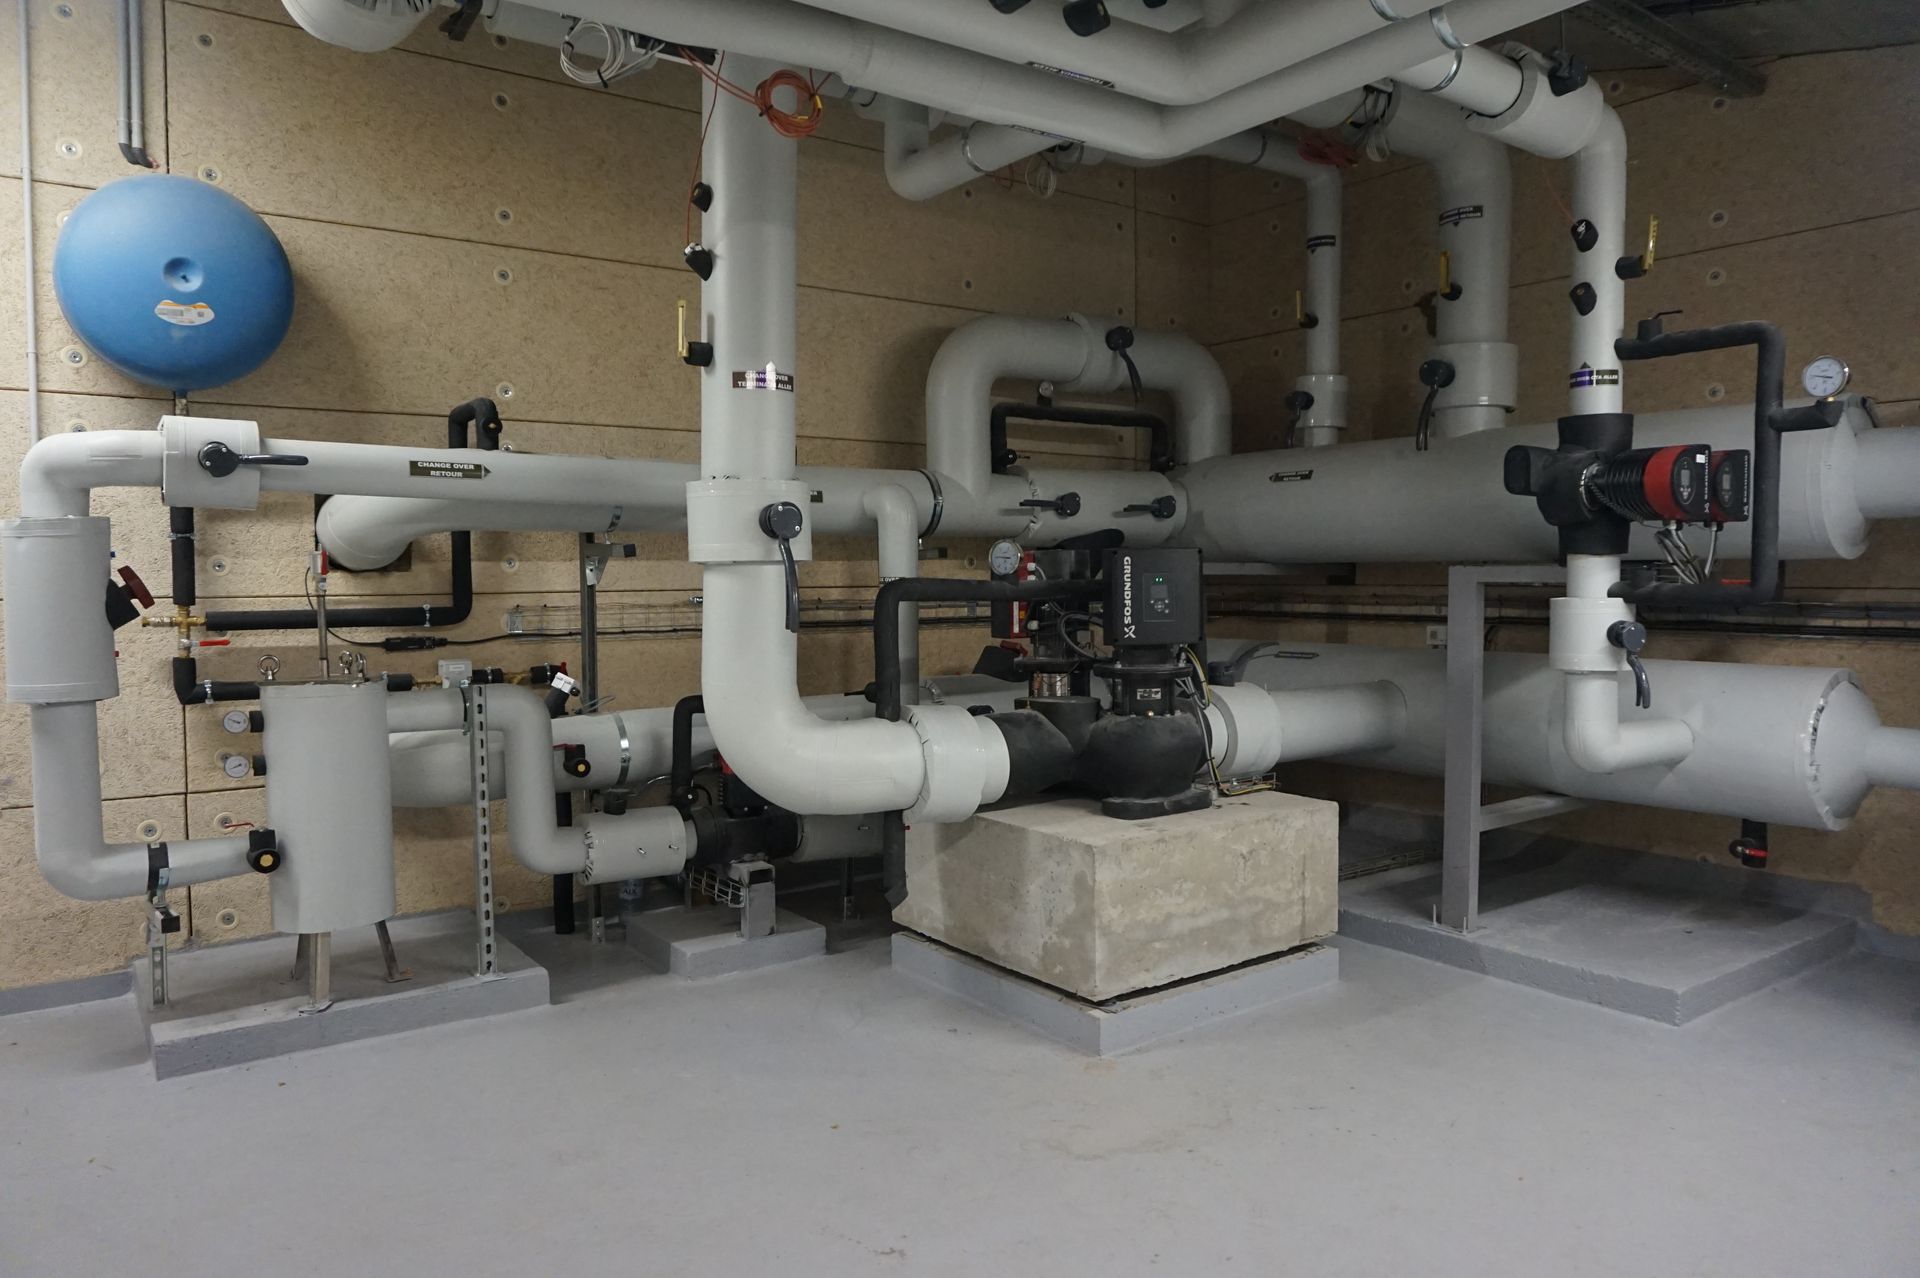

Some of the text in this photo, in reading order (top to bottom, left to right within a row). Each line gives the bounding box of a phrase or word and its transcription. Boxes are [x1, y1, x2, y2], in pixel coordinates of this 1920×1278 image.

[777, 382, 792, 390] ALLER
[417, 461, 452, 469] CHANGE
[430, 470, 463, 478] RETOUR
[1123, 556, 1132, 625] GRUNDFOS
